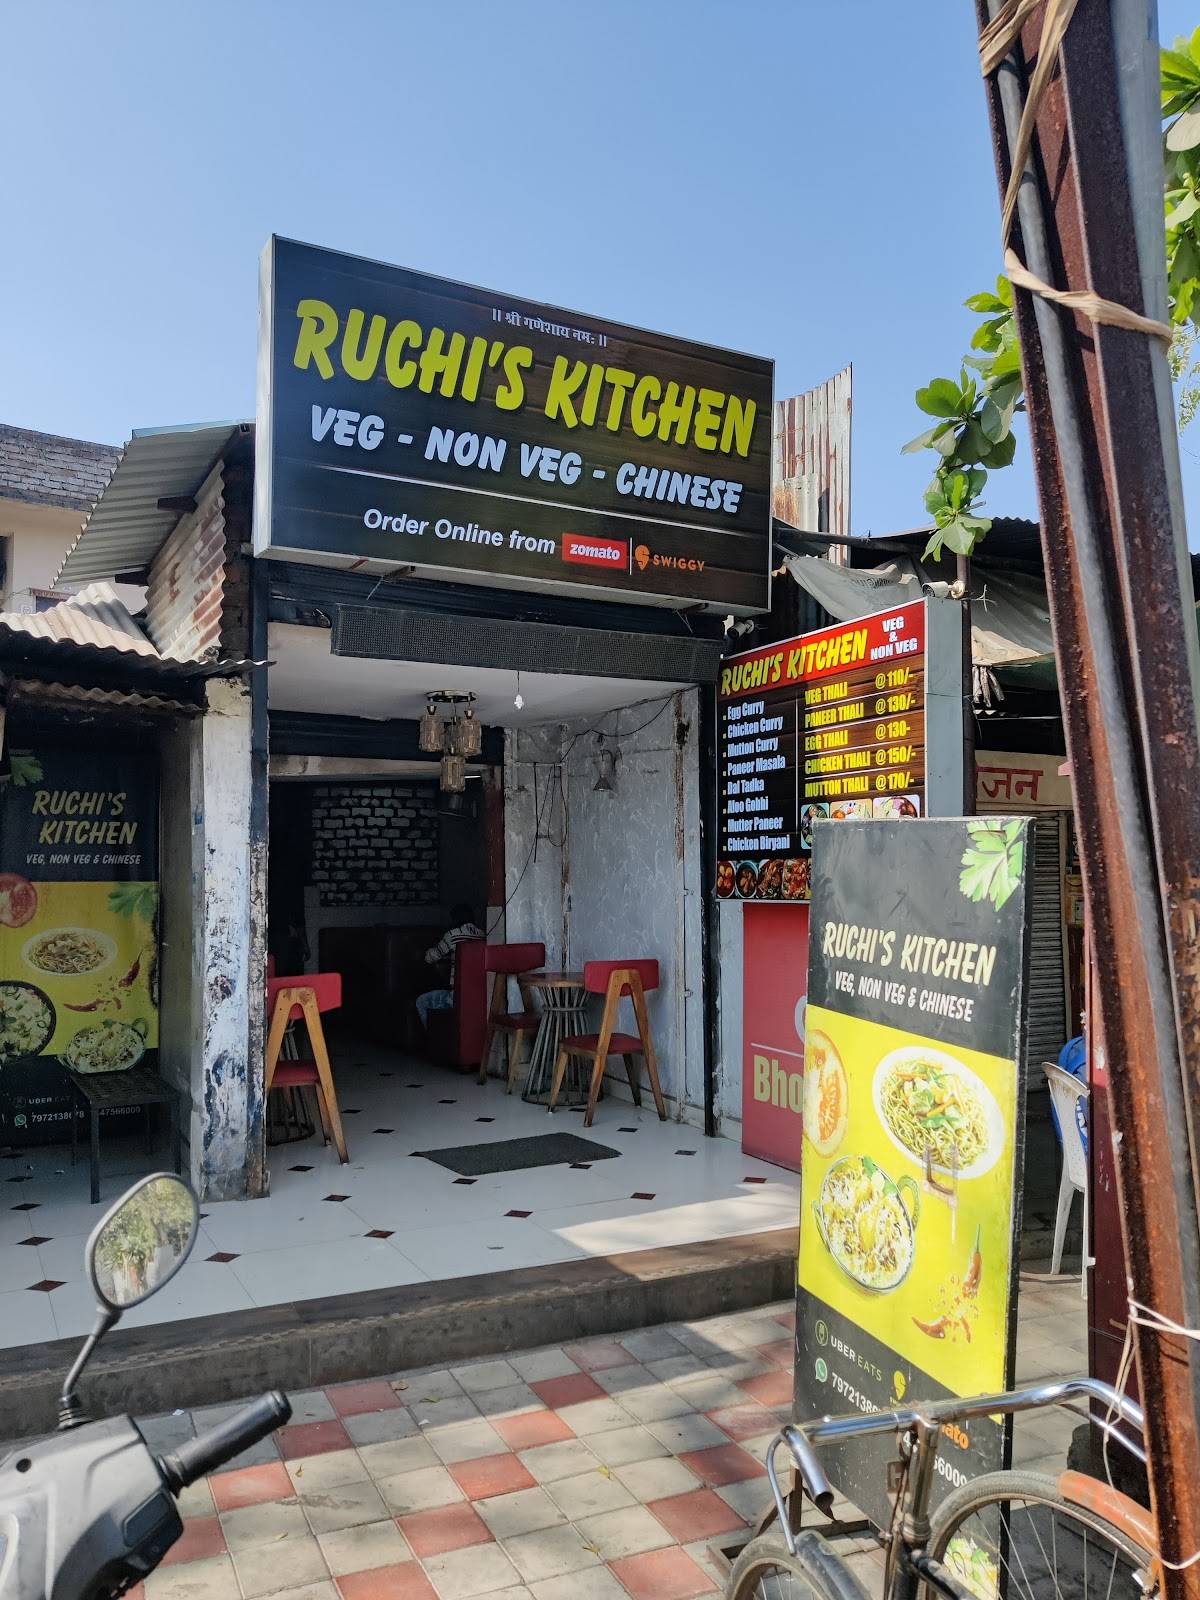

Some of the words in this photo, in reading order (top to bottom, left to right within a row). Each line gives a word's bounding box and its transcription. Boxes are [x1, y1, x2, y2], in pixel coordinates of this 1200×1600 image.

[505, 311, 521, 327] श्री
[523, 316, 571, 338] गणेशाय
[293, 299, 533, 411] RUCHI'S
[544, 355, 757, 458] KITCHEN
[311, 404, 385, 451] VEG
[424, 425, 507, 472] NON
[519, 443, 582, 486] VEG
[616, 462, 743, 514] CHINESE
[363, 508, 429, 536] Order
[434, 519, 504, 547] Online
[509, 530, 556, 555] from
[569, 543, 621, 561] zomato
[653, 554, 705, 572] SWIGGY
[882, 616, 904, 633] VEG
[889, 632, 898, 642] &
[870, 643, 893, 660] NON
[895, 638, 918, 654] VEG
[720, 652, 784, 696] RUCHI'S
[787, 629, 868, 680] KITCHEN
[805, 688, 821, 705] VEG
[823, 682, 848, 701] THALI
[728, 706, 742, 720] Egg
[742, 701, 765, 716] Curry
[805, 709, 837, 728] PANEER
[838, 703, 864, 721] THALI
[728, 721, 760, 738] Chicken
[760, 716, 784, 732] Curry
[728, 742, 754, 757] Mutton
[755, 737, 779, 752] Curry
[805, 734, 822, 751] EGG
[823, 730, 849, 748] THALI
[728, 761, 755, 776] Paneer
[756, 754, 786, 772] Masala
[805, 756, 843, 774] CHICKEN
[844, 751, 871, 769] THALI
[727, 780, 740, 795] Dal
[741, 777, 765, 793] Tadka
[805, 780, 841, 798] MUTTON
[842, 776, 869, 793] THALI
[31, 790, 127, 816] RUCHI'S
[727, 800, 745, 814] Aloo
[745, 796, 769, 812] Gobhi
[38, 821, 138, 846] KITCHEN
[728, 818, 754, 833] Mutter
[754, 817, 784, 831] Paneer
[728, 837, 760, 852] Chicken
[760, 834, 790, 851] Biryani
[26, 853, 46, 865] VEG,
[49, 853, 71, 865] NON
[73, 854, 91, 865] VEG
[93, 854, 99, 864] &
[102, 853, 142, 865] CHINESE
[823, 921, 897, 967] RUCHI'S
[900, 933, 997, 987] KITCHEN
[835, 970, 856, 996] VEG,
[858, 975, 881, 1000] NON
[884, 981, 906, 1006] VEG
[908, 988, 917, 1008] &
[919, 989, 975, 1023] CHINESE
[830, 1335, 856, 1362] UBER
[857, 1354, 882, 1381] EATS
